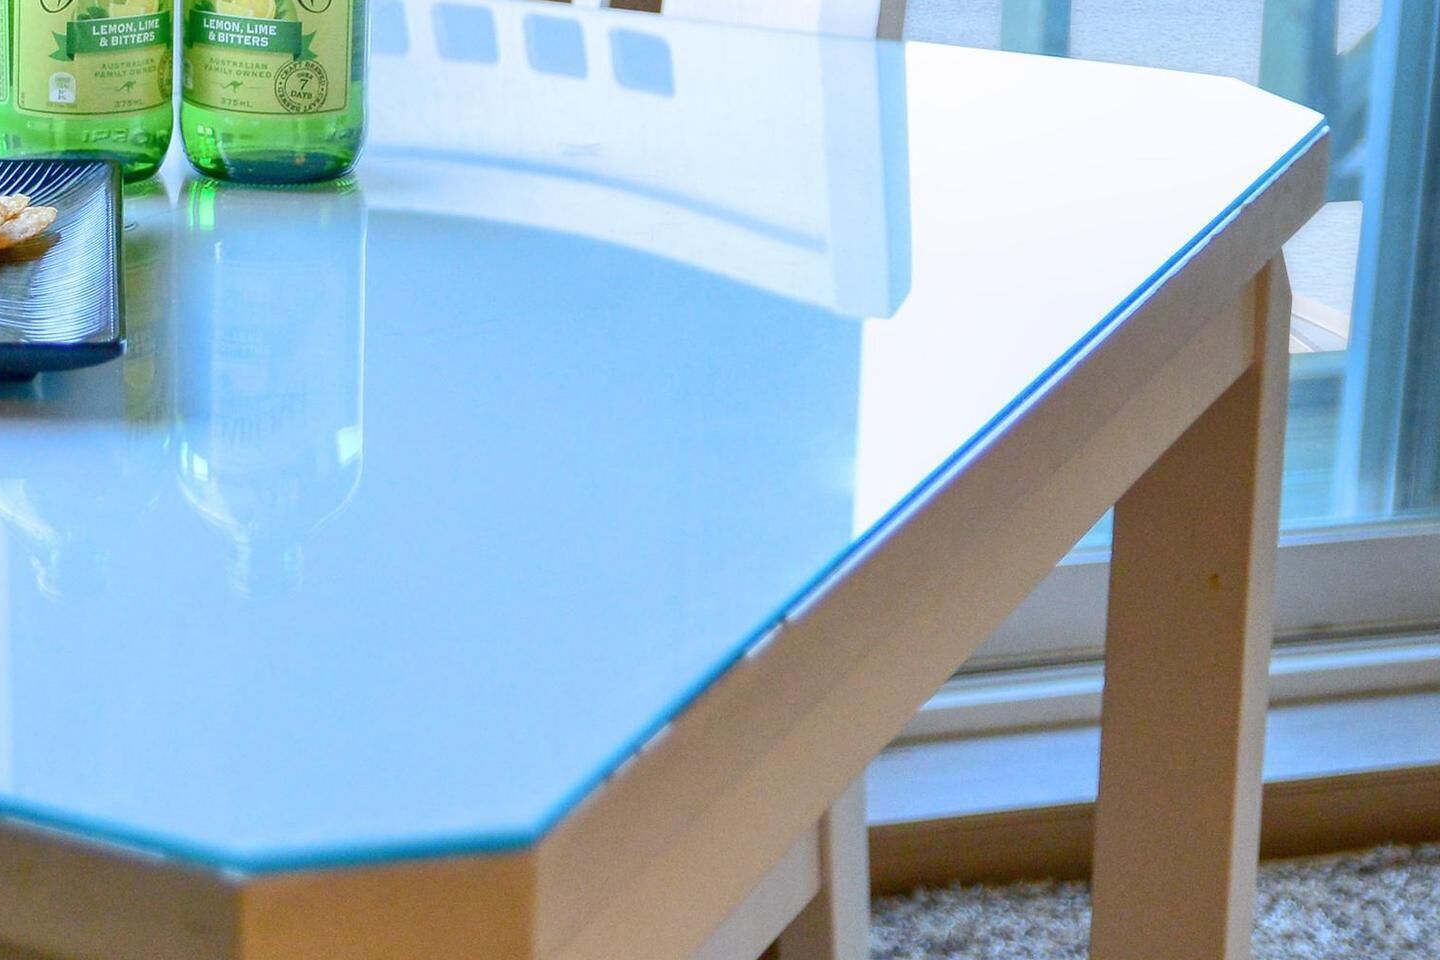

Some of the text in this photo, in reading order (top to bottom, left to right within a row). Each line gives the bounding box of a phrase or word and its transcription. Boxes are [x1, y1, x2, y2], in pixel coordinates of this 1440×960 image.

[92, 18, 160, 37] LEMON, LIME
[203, 18, 277, 36] LEMON, LIME
[99, 32, 155, 47] & BITTERS
[208, 31, 269, 47] & BITTERS
[209, 57, 268, 70] AUSTRALIAN
[236, 70, 272, 79] OWNED
[300, 78, 309, 90] 7
[290, 90, 313, 100] DAYS
